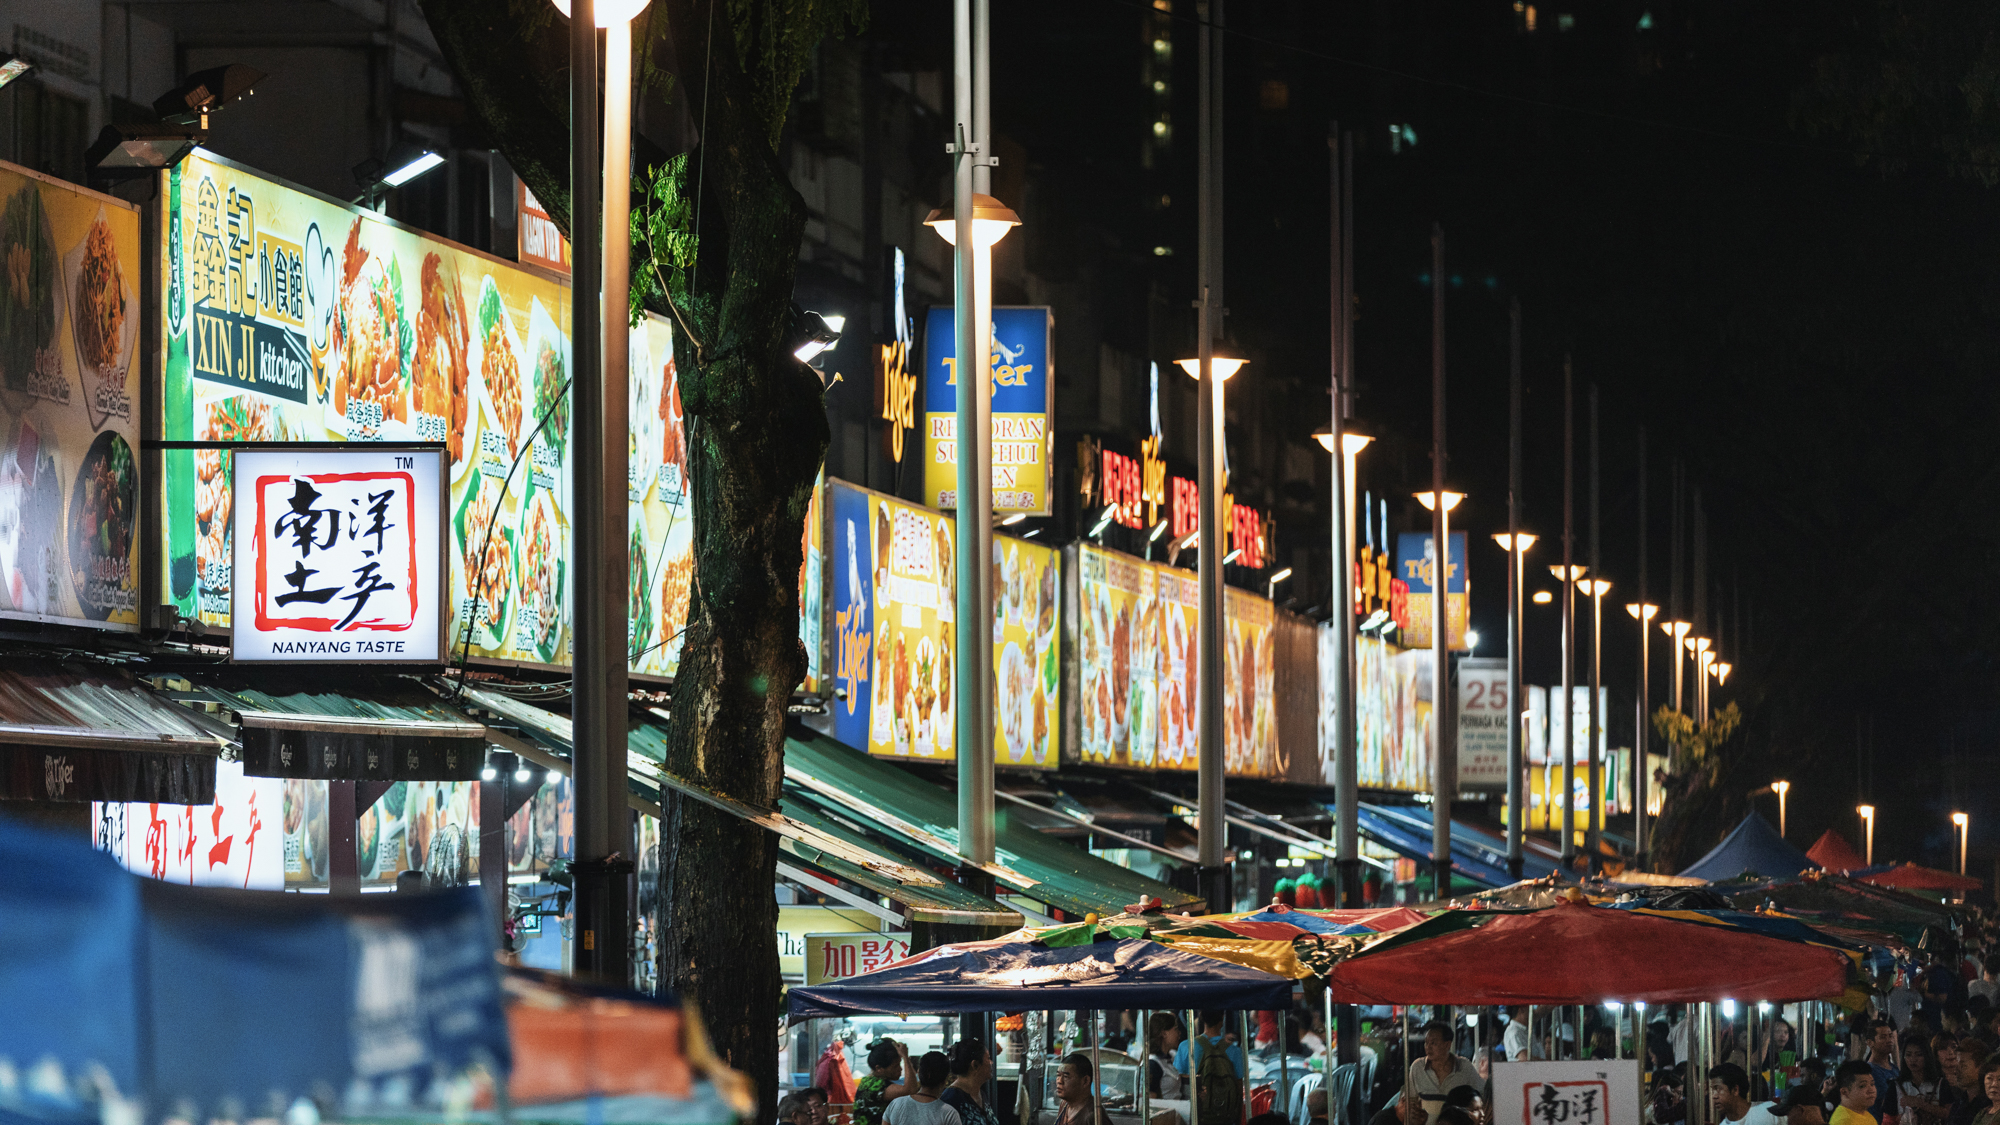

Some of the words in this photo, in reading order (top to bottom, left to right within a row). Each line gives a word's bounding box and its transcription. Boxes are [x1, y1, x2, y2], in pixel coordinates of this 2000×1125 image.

[193, 176, 257, 317] 鑫記
[259, 241, 304, 321] 小食館
[195, 312, 233, 378] XIN
[238, 323, 257, 384] JI
[260, 341, 304, 391] kitchen
[881, 340, 918, 464] Tiger
[933, 418, 1044, 439] REORAN
[394, 457, 414, 470] TM
[938, 490, 1036, 509] 新酒家
[274, 478, 396, 558] 南洋
[272, 641, 351, 654] NANYANG
[356, 641, 405, 653] TASTE
[836, 604, 871, 716] Tiger
